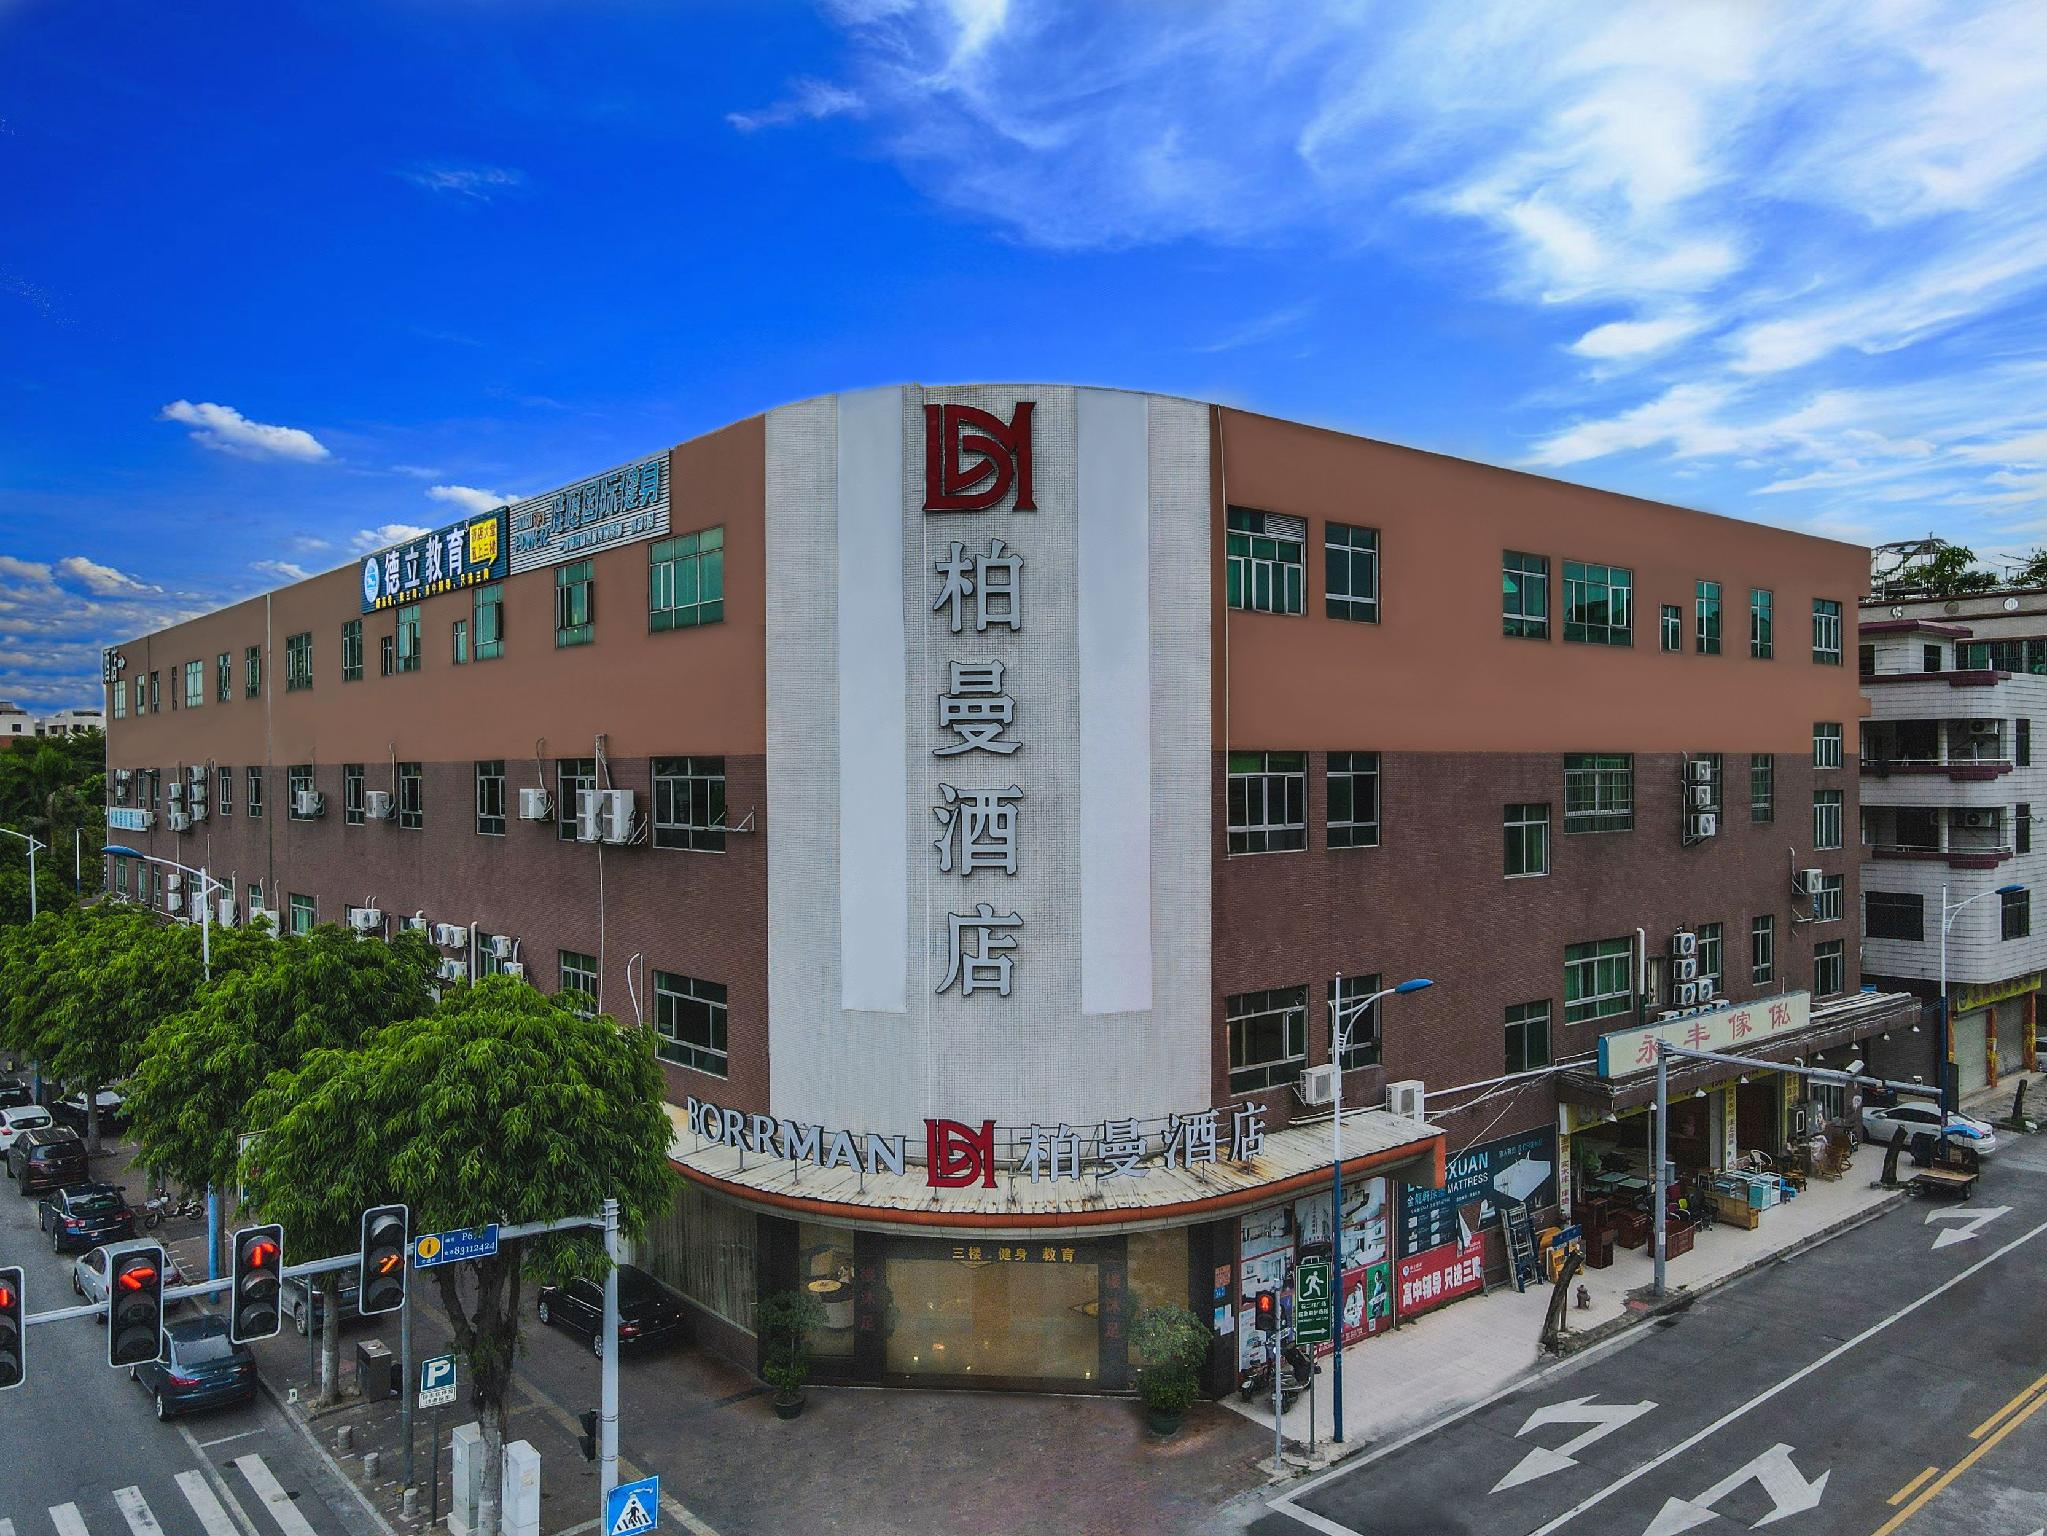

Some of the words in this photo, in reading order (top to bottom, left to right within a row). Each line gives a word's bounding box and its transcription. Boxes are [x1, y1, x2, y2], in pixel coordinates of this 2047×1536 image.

[384, 527, 465, 596] 德立教育
[932, 538, 1024, 997] 柏曼酒店
[687, 1096, 906, 1177] BORRMAN
[1019, 1101, 1269, 1184] 柏曼酒店
[1447, 1172, 1490, 1194] MATTRESS
[952, 1246, 982, 1261] 三楼
[998, 1246, 1028, 1262] 健身
[1042, 1246, 1077, 1264] 教育
[427, 1360, 450, 1387] P
